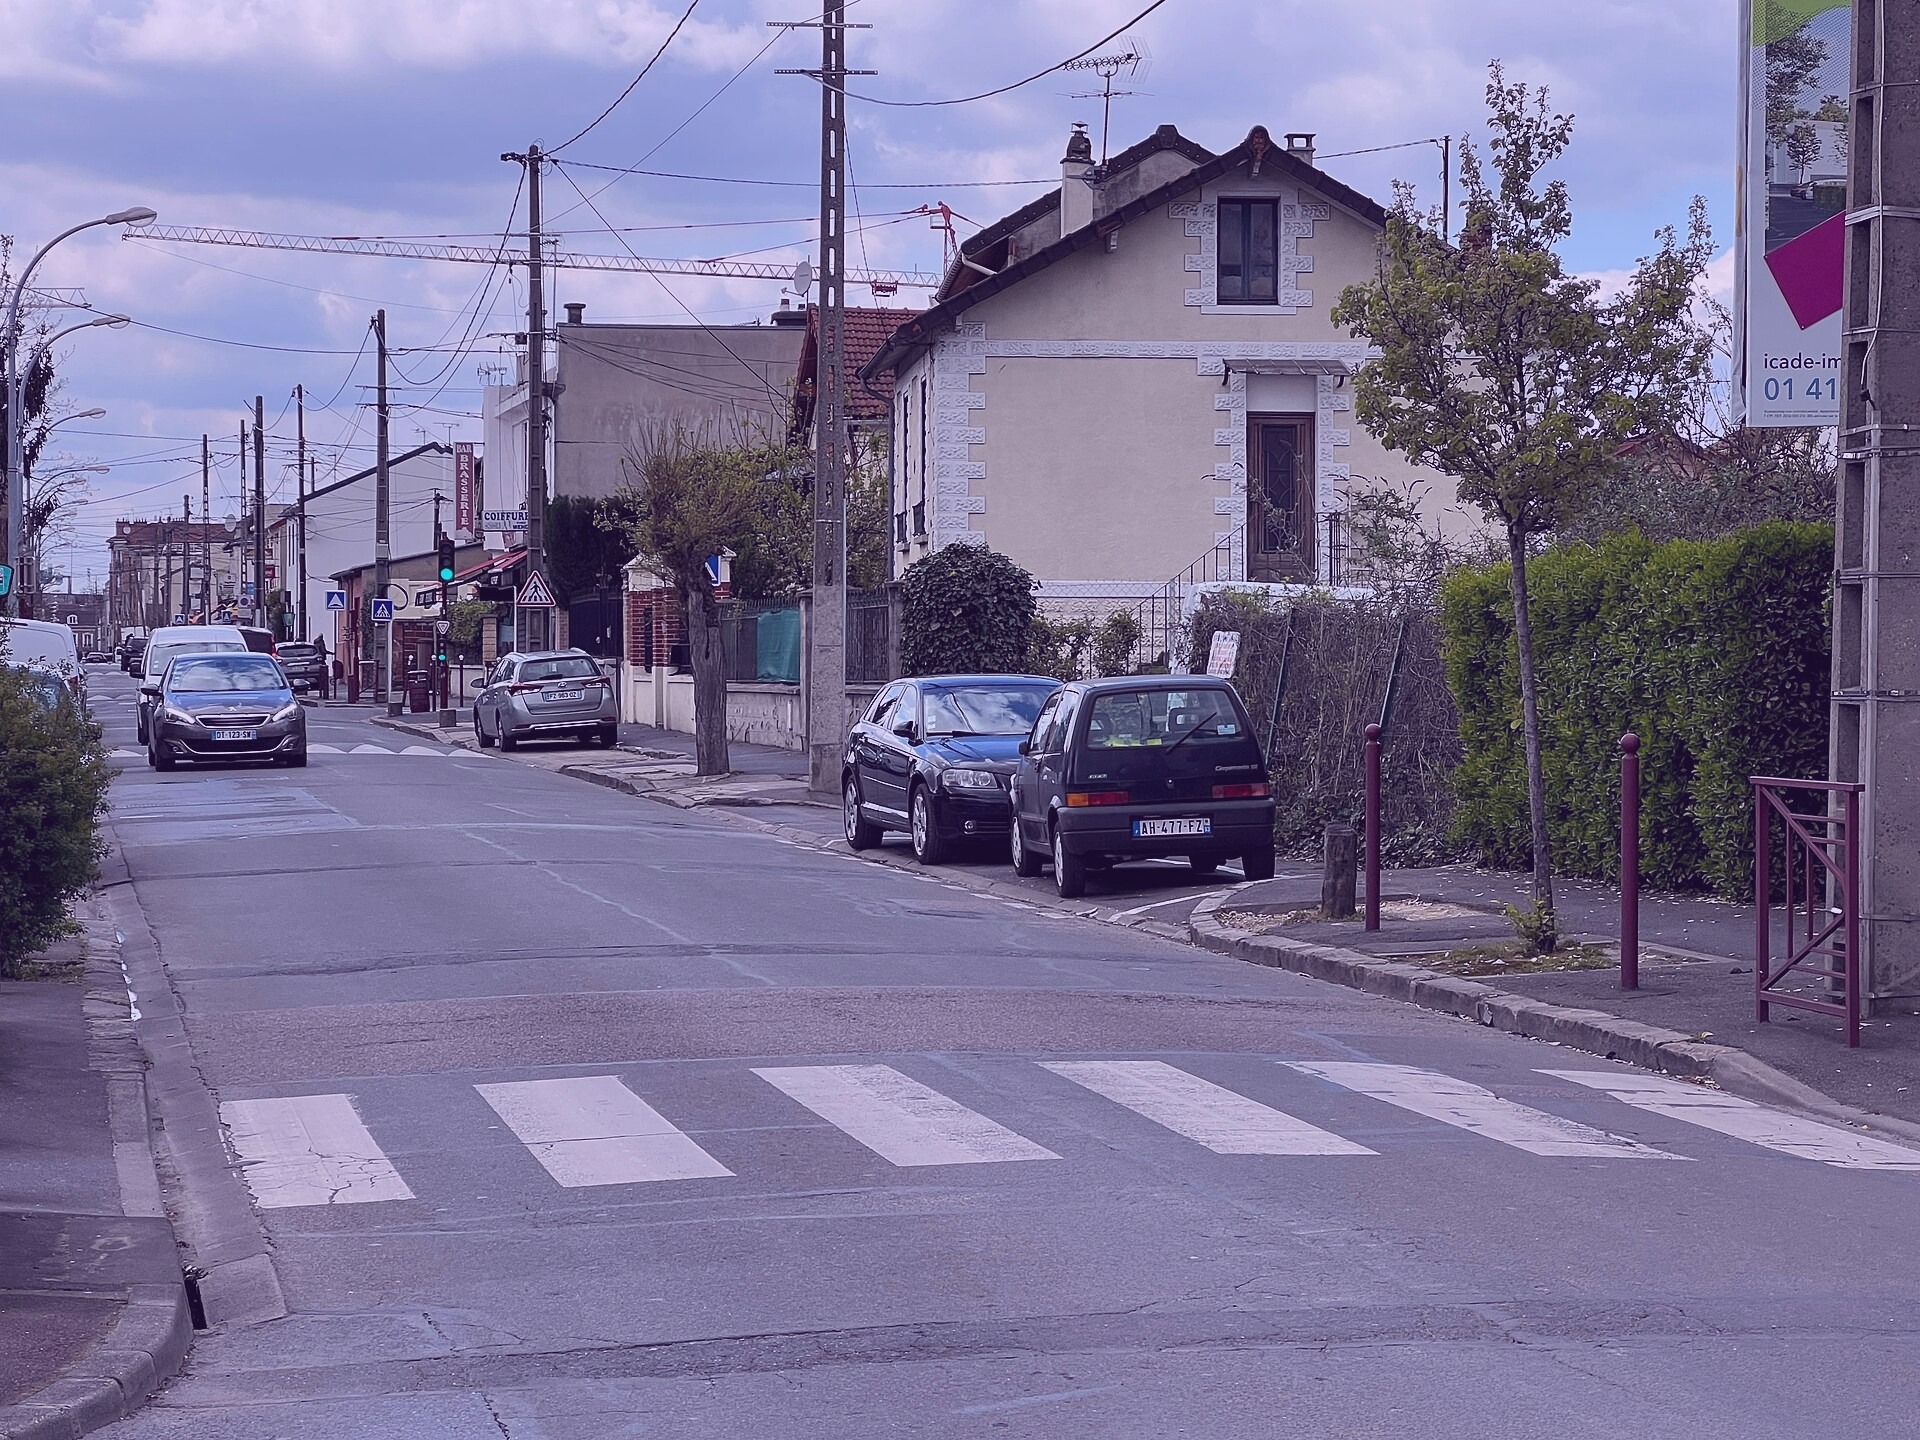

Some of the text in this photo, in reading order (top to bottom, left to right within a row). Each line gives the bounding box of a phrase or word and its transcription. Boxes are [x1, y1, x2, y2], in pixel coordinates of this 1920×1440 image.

[1764, 377, 1836, 401] 01 41
[456, 444, 472, 453] BAR
[459, 454, 470, 525] BRASSERIE
[1141, 819, 1203, 835] AH-477-FZ
